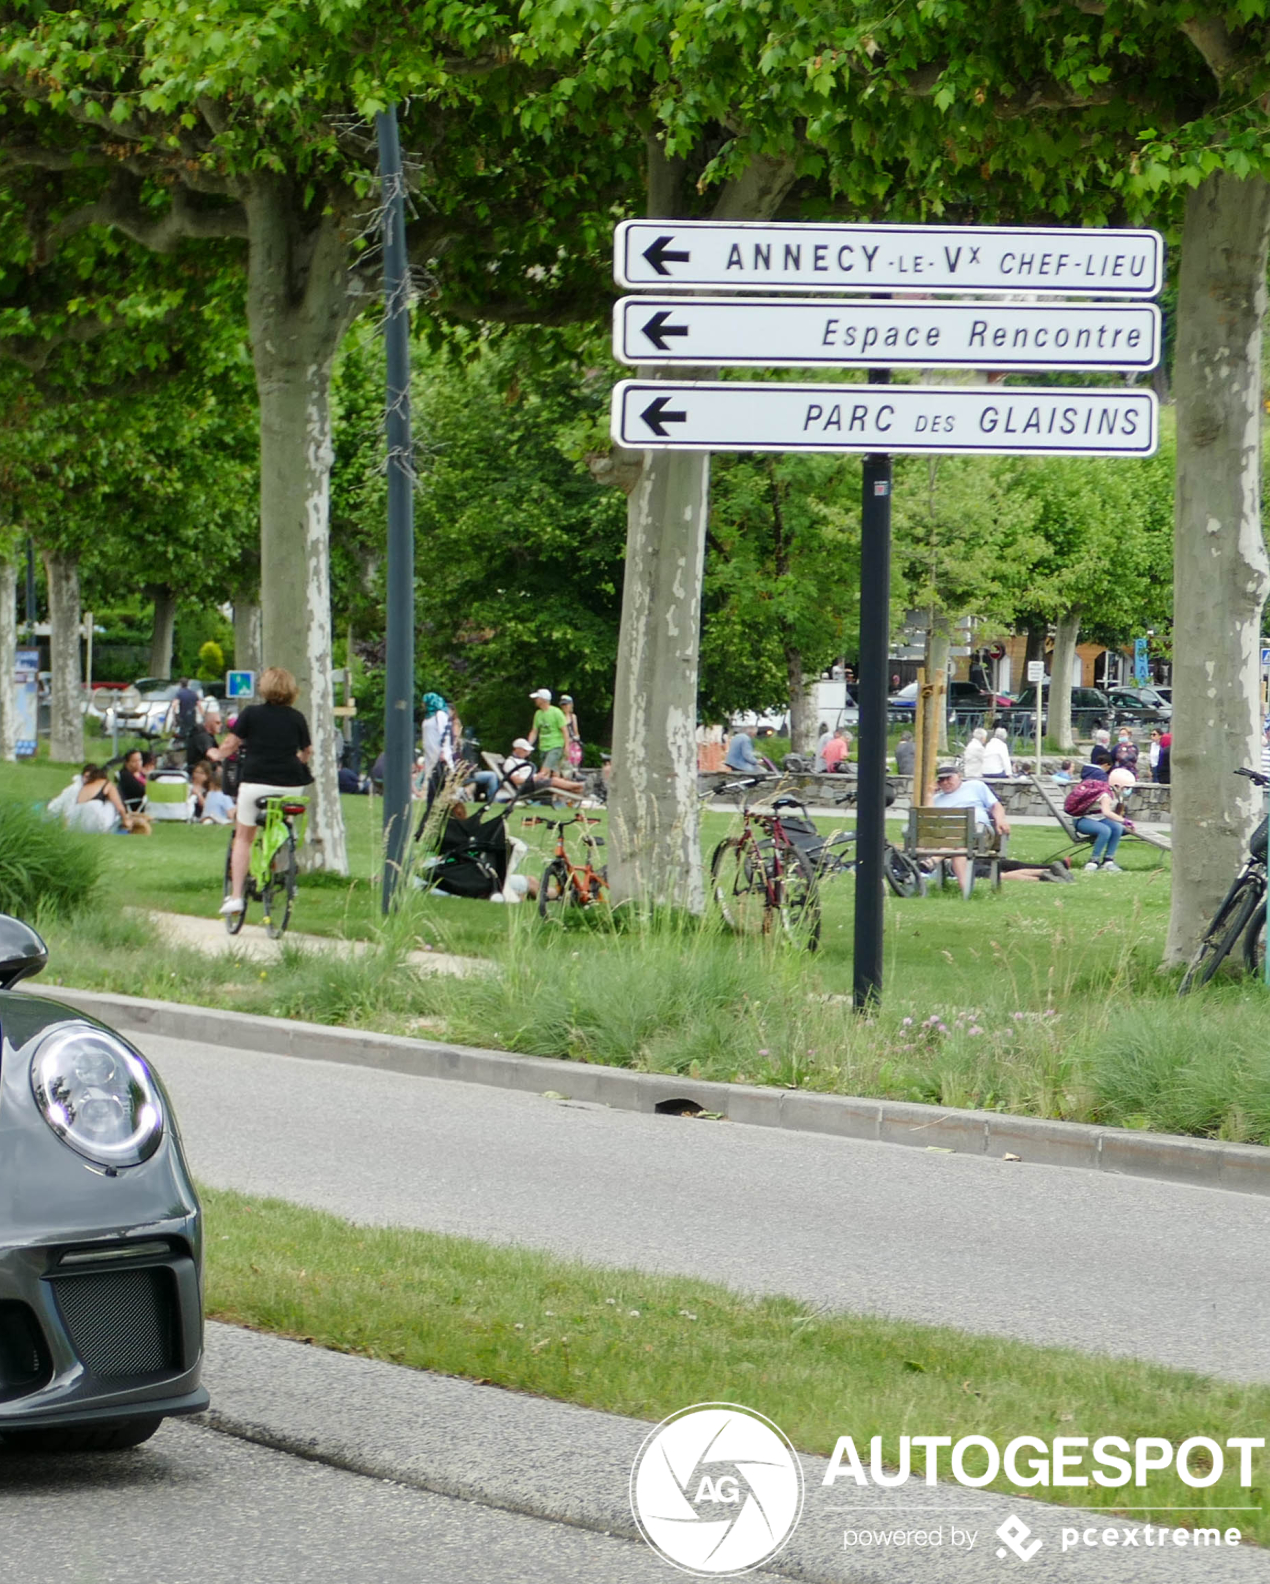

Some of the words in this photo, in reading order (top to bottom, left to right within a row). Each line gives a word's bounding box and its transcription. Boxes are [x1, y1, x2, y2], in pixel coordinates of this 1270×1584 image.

[1000, 252, 1146, 277] CHEF-LIEU
[822, 319, 941, 354] Espace
[968, 320, 1141, 348] Rencontre
[803, 404, 895, 432] PARC
[915, 415, 955, 433] DES
[979, 406, 1139, 436] GLAISINS
